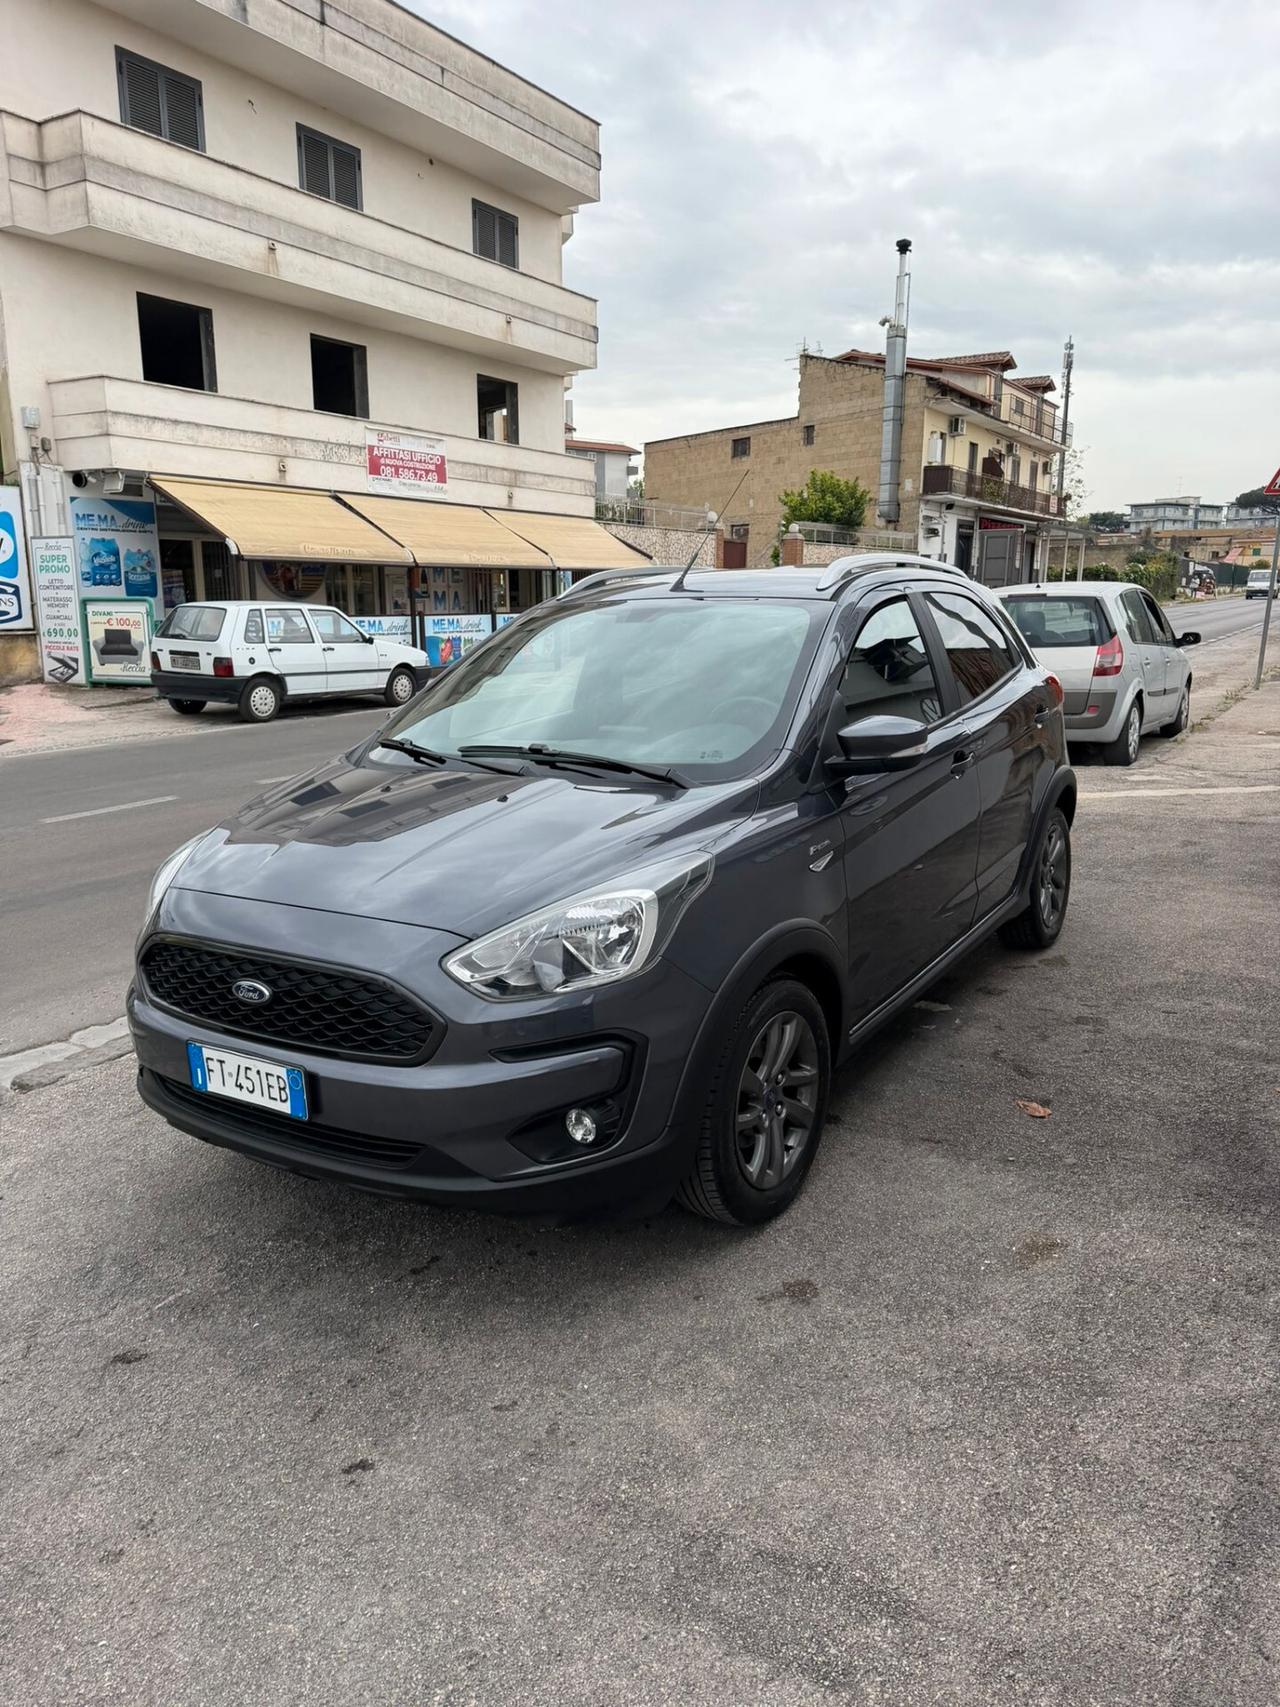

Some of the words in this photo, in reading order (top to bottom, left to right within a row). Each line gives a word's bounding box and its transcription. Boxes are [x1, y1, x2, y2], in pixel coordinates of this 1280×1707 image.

[373, 447, 411, 461] AFFITTASI
[412, 452, 441, 465] UFFICIO
[40, 554, 67, 564] SUPER
[39, 564, 71, 574] PROMO
[238, 985, 260, 1000] Ford
